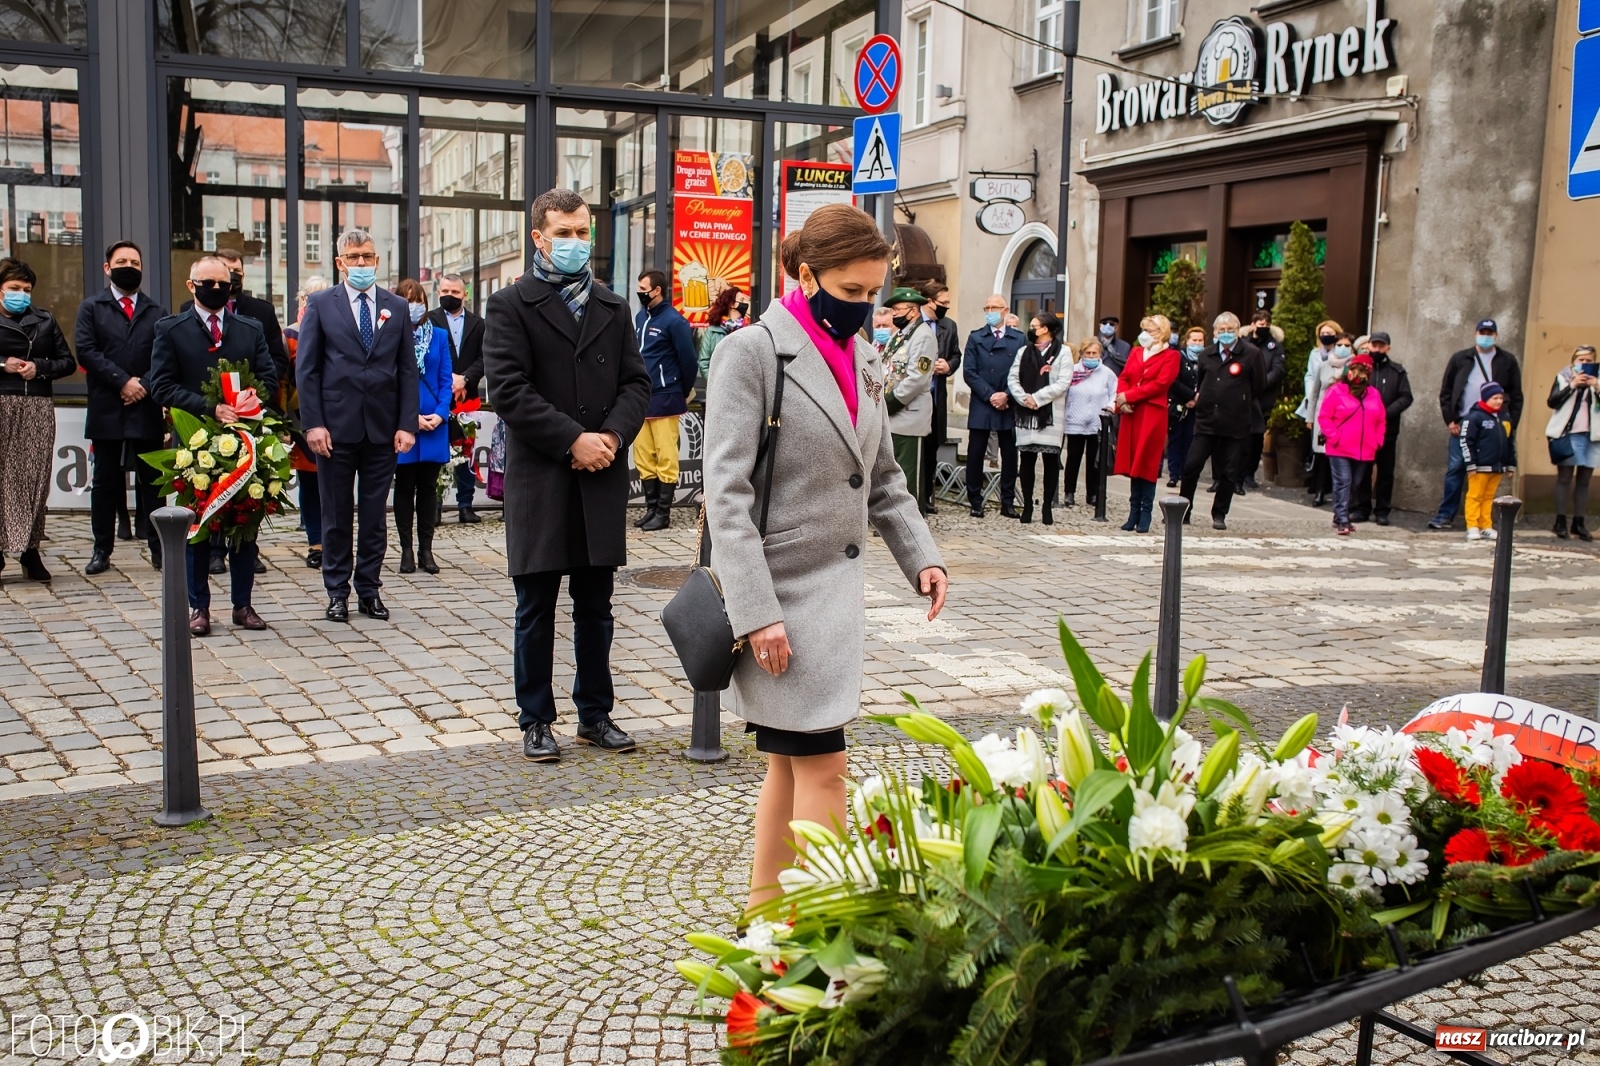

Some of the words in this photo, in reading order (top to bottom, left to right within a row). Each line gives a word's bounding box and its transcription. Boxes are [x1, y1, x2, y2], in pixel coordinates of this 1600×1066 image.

[1096, 71, 1194, 135] Browar
[1264, 0, 1391, 103] Rynek
[676, 152, 692, 163] Pizza
[693, 154, 709, 164] Time
[676, 165, 696, 178] Druga
[696, 167, 712, 178] pizza
[796, 168, 845, 183] LUNCH
[685, 177, 707, 190] gratis!
[987, 181, 1020, 196] BUTIK
[685, 199, 743, 220] Promocja
[693, 221, 713, 230] DWA
[713, 222, 733, 231] PIWA
[680, 230, 688, 238] W
[689, 230, 711, 239] CENIE
[712, 232, 746, 241] JEDNEGO
[676, 468, 702, 489] yne
